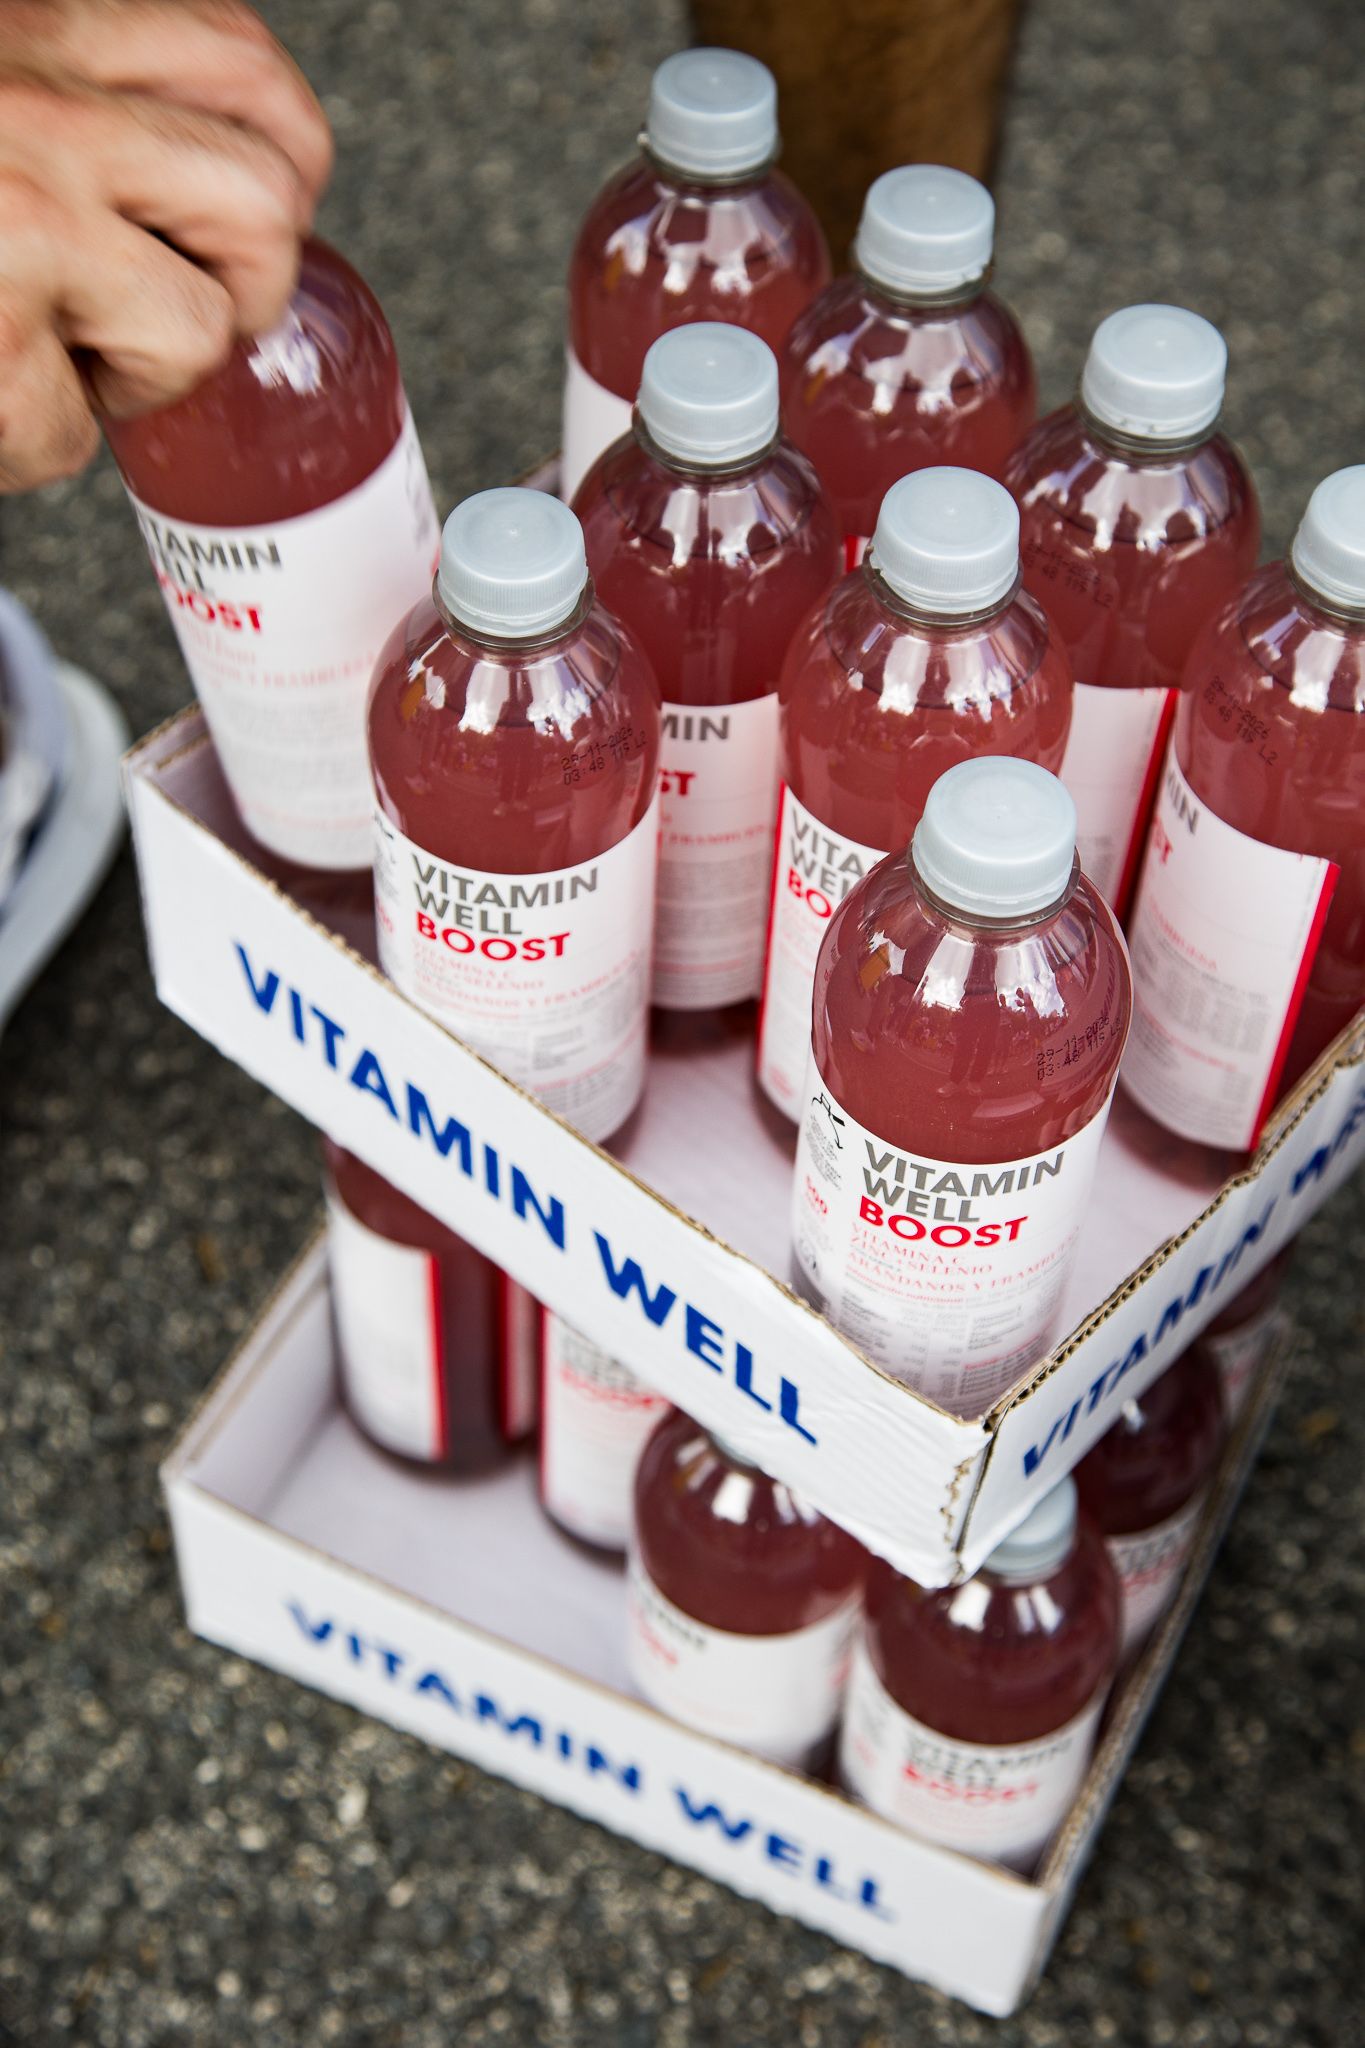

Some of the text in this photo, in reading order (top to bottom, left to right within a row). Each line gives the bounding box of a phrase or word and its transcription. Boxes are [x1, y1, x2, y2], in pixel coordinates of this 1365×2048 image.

[792, 807, 864, 877] VITA
[411, 853, 599, 909] VITAMIN
[414, 882, 523, 936] WELL
[415, 911, 571, 963] BOOST
[234, 941, 568, 1253] VITAMIN
[592, 1229, 819, 1447] WELL
[862, 1166, 980, 1223] WELL
[864, 1139, 1064, 1197] VITAMIN
[859, 1195, 1029, 1249] BOOST
[1022, 1197, 1278, 1479] VITAMIN
[286, 1600, 898, 1922] VITAMIN WELL
